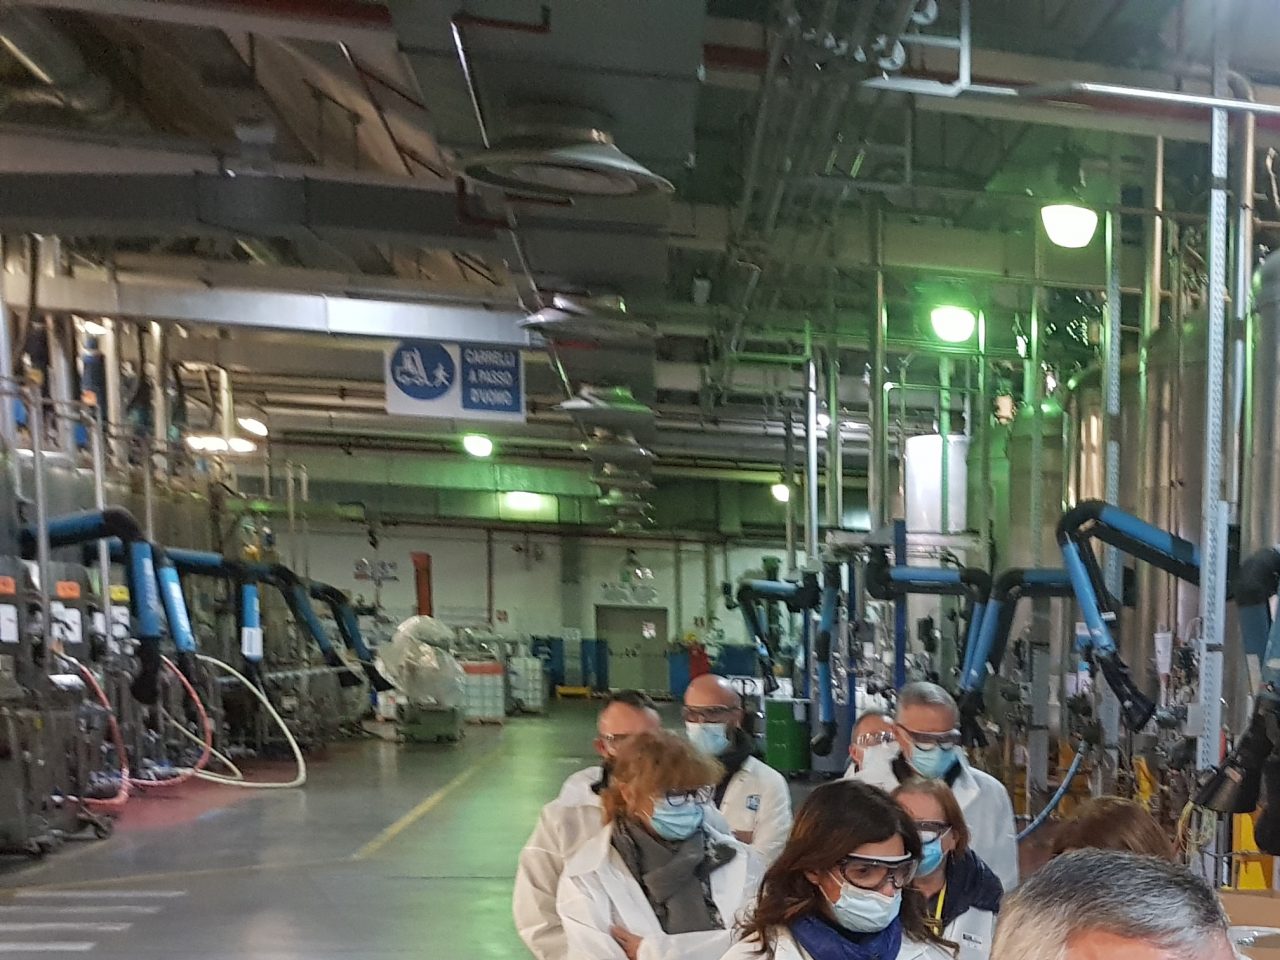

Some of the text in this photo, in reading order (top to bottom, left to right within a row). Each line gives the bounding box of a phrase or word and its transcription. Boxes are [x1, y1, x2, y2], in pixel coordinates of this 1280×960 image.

[464, 349, 516, 368] CARRELLI
[468, 368, 513, 386] A PASSO
